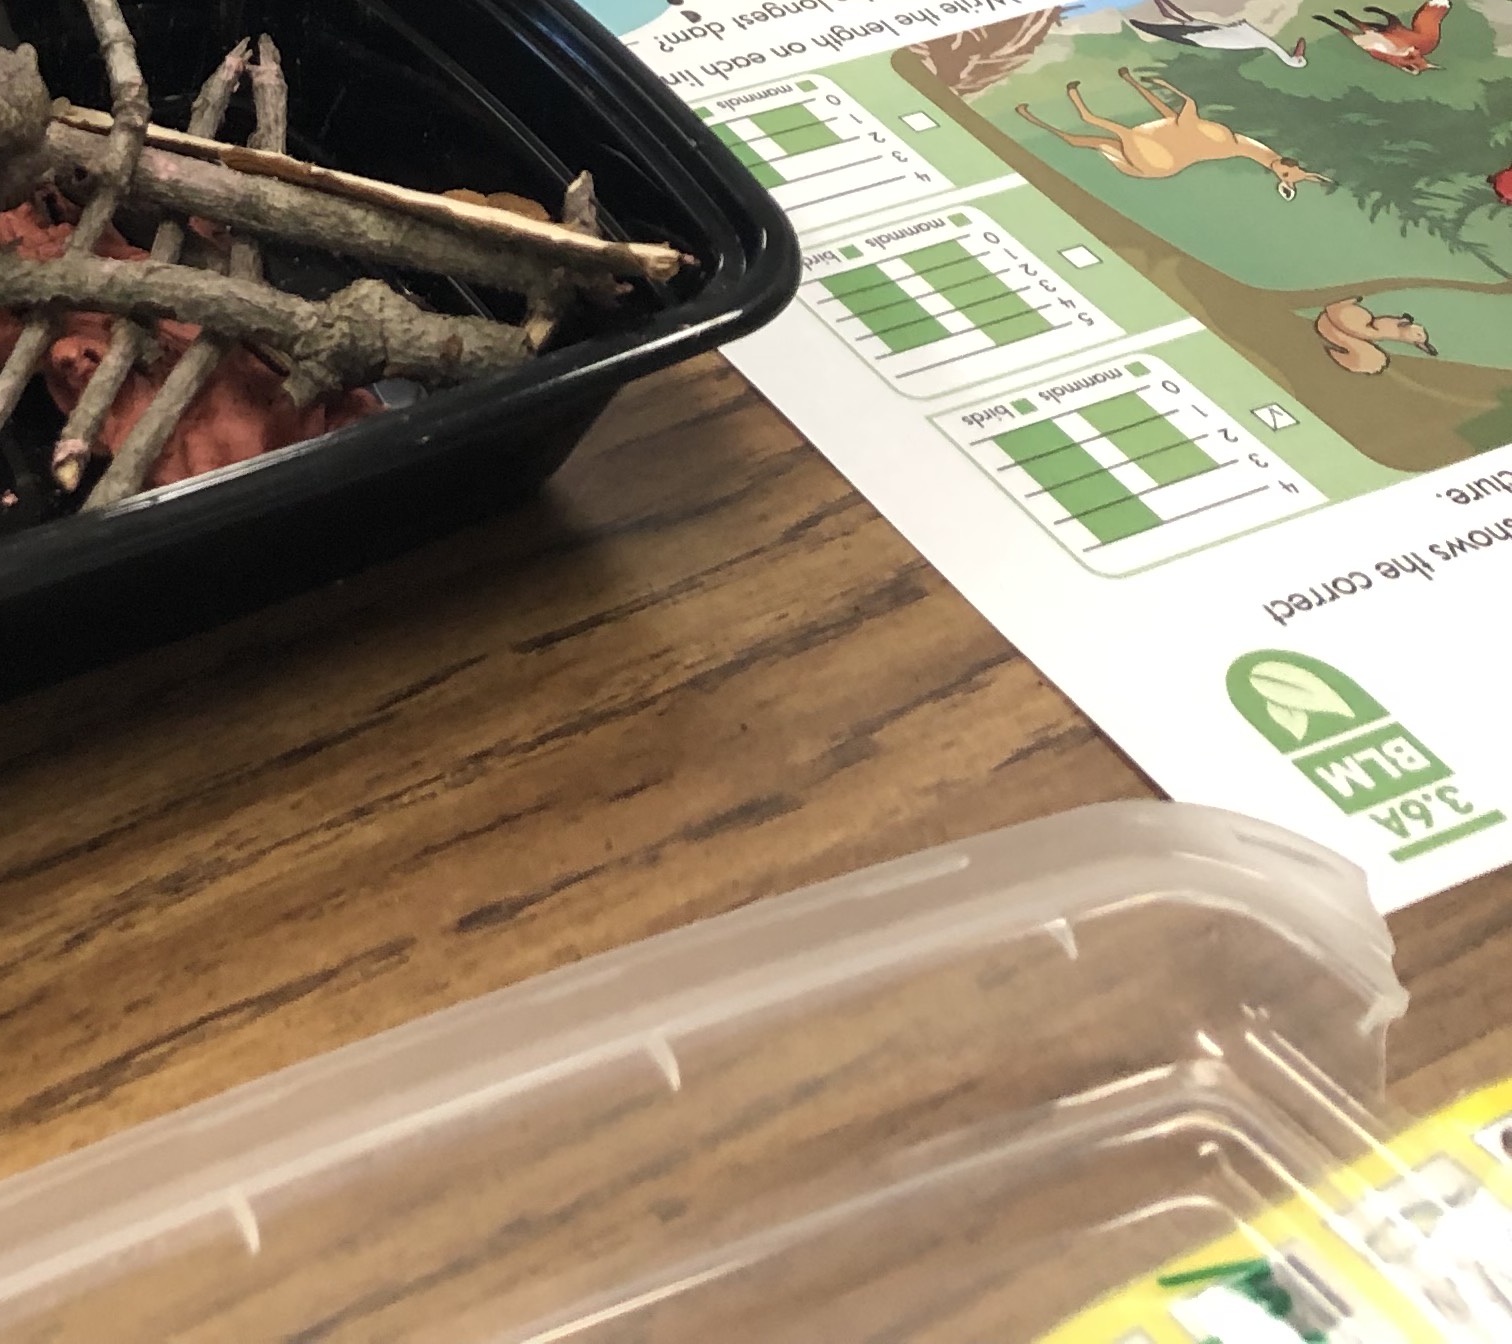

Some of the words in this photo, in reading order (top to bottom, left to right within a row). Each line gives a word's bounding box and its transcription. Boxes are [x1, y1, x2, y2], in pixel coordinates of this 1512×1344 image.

[895, 7, 941, 29] the
[652, 20, 726, 54] dam?
[811, 17, 901, 53] length
[770, 40, 807, 60] on
[700, 51, 767, 81] each
[658, 68, 705, 89] lin
[716, 83, 794, 112] mammals
[825, 93, 842, 107] 0
[868, 131, 886, 144] 2
[891, 150, 909, 163] 3
[914, 171, 931, 183] 4
[865, 217, 947, 250] mammals
[982, 231, 1001, 245] 0
[801, 250, 842, 272] bird
[1018, 263, 1038, 277] 2
[1039, 279, 1057, 293] 3
[1057, 296, 1076, 310] 4
[1077, 311, 1095, 327] 5
[1038, 367, 1123, 405] mammals
[1161, 380, 1181, 395] 0
[961, 404, 1016, 429] birds
[1217, 427, 1239, 444] 2
[1248, 452, 1269, 469] 3
[1278, 480, 1300, 495] 4
[1375, 551, 1436, 582] the
[1262, 570, 1374, 627] correct
[1314, 736, 1431, 799] BLM
[1368, 784, 1475, 840] 3.6A
